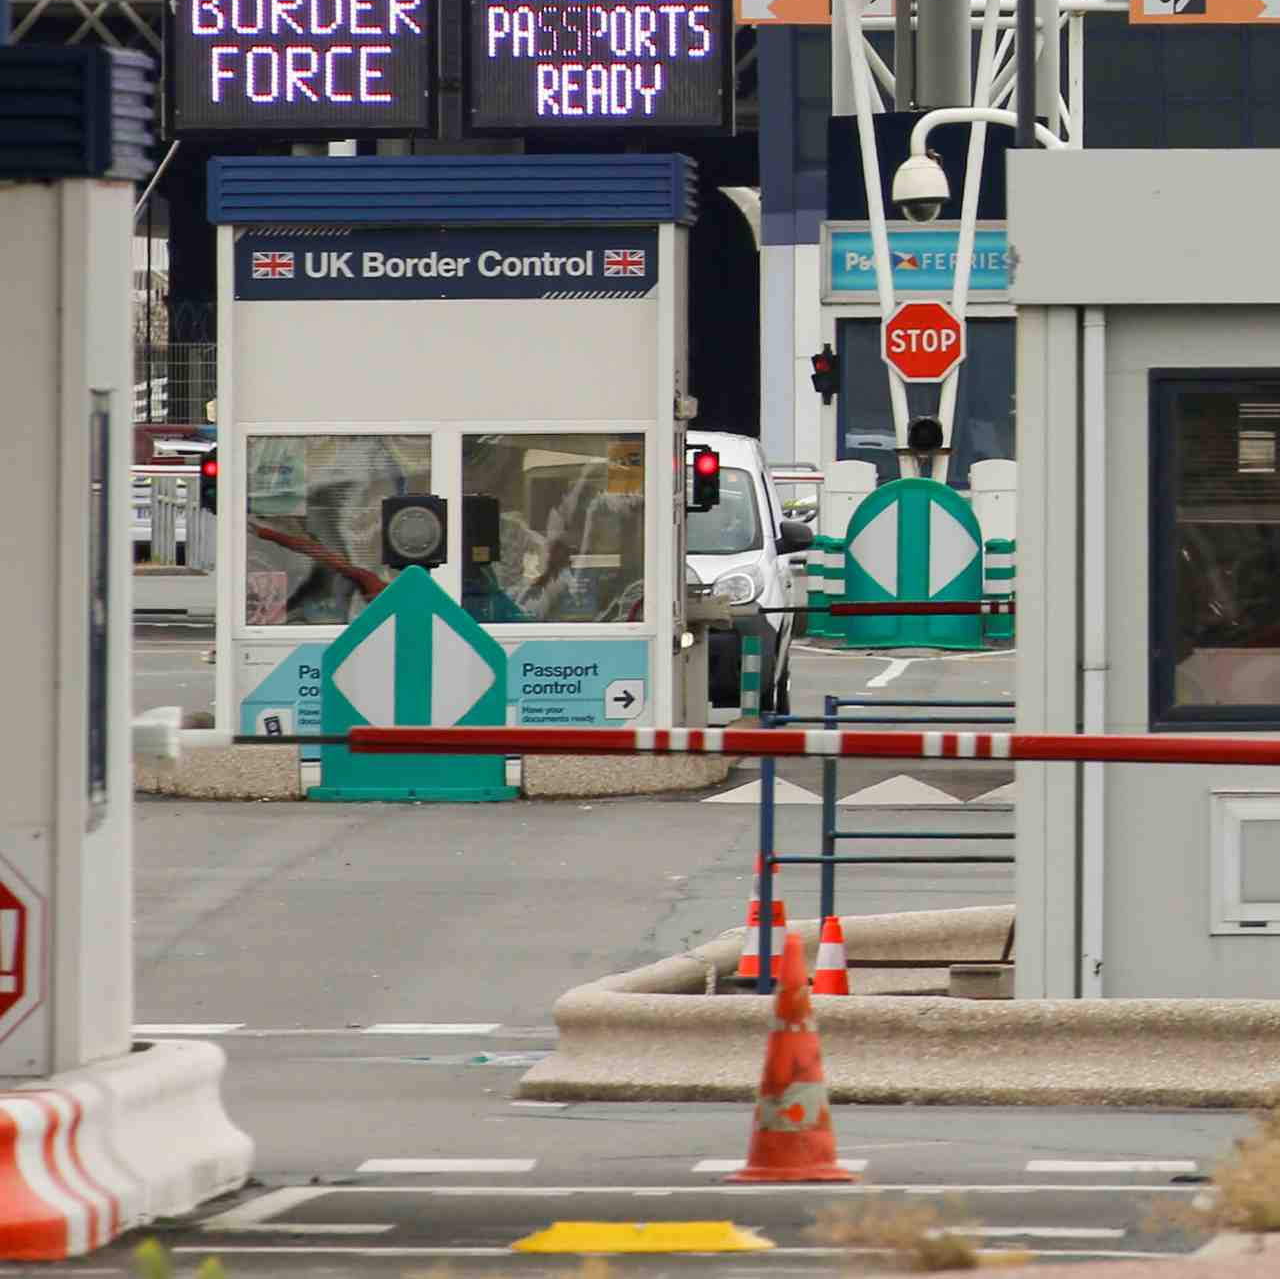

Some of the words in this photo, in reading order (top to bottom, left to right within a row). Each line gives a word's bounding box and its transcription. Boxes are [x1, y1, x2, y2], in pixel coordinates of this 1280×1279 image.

[486, 6, 712, 59] PASSPORTS
[211, 46, 393, 103] FORCE
[536, 63, 663, 116] READY
[304, 252, 355, 278] UK
[362, 251, 470, 278] Border
[477, 250, 593, 277] Control
[891, 328, 957, 353] STOP
[522, 663, 599, 680] Passport
[522, 680, 582, 694] control
